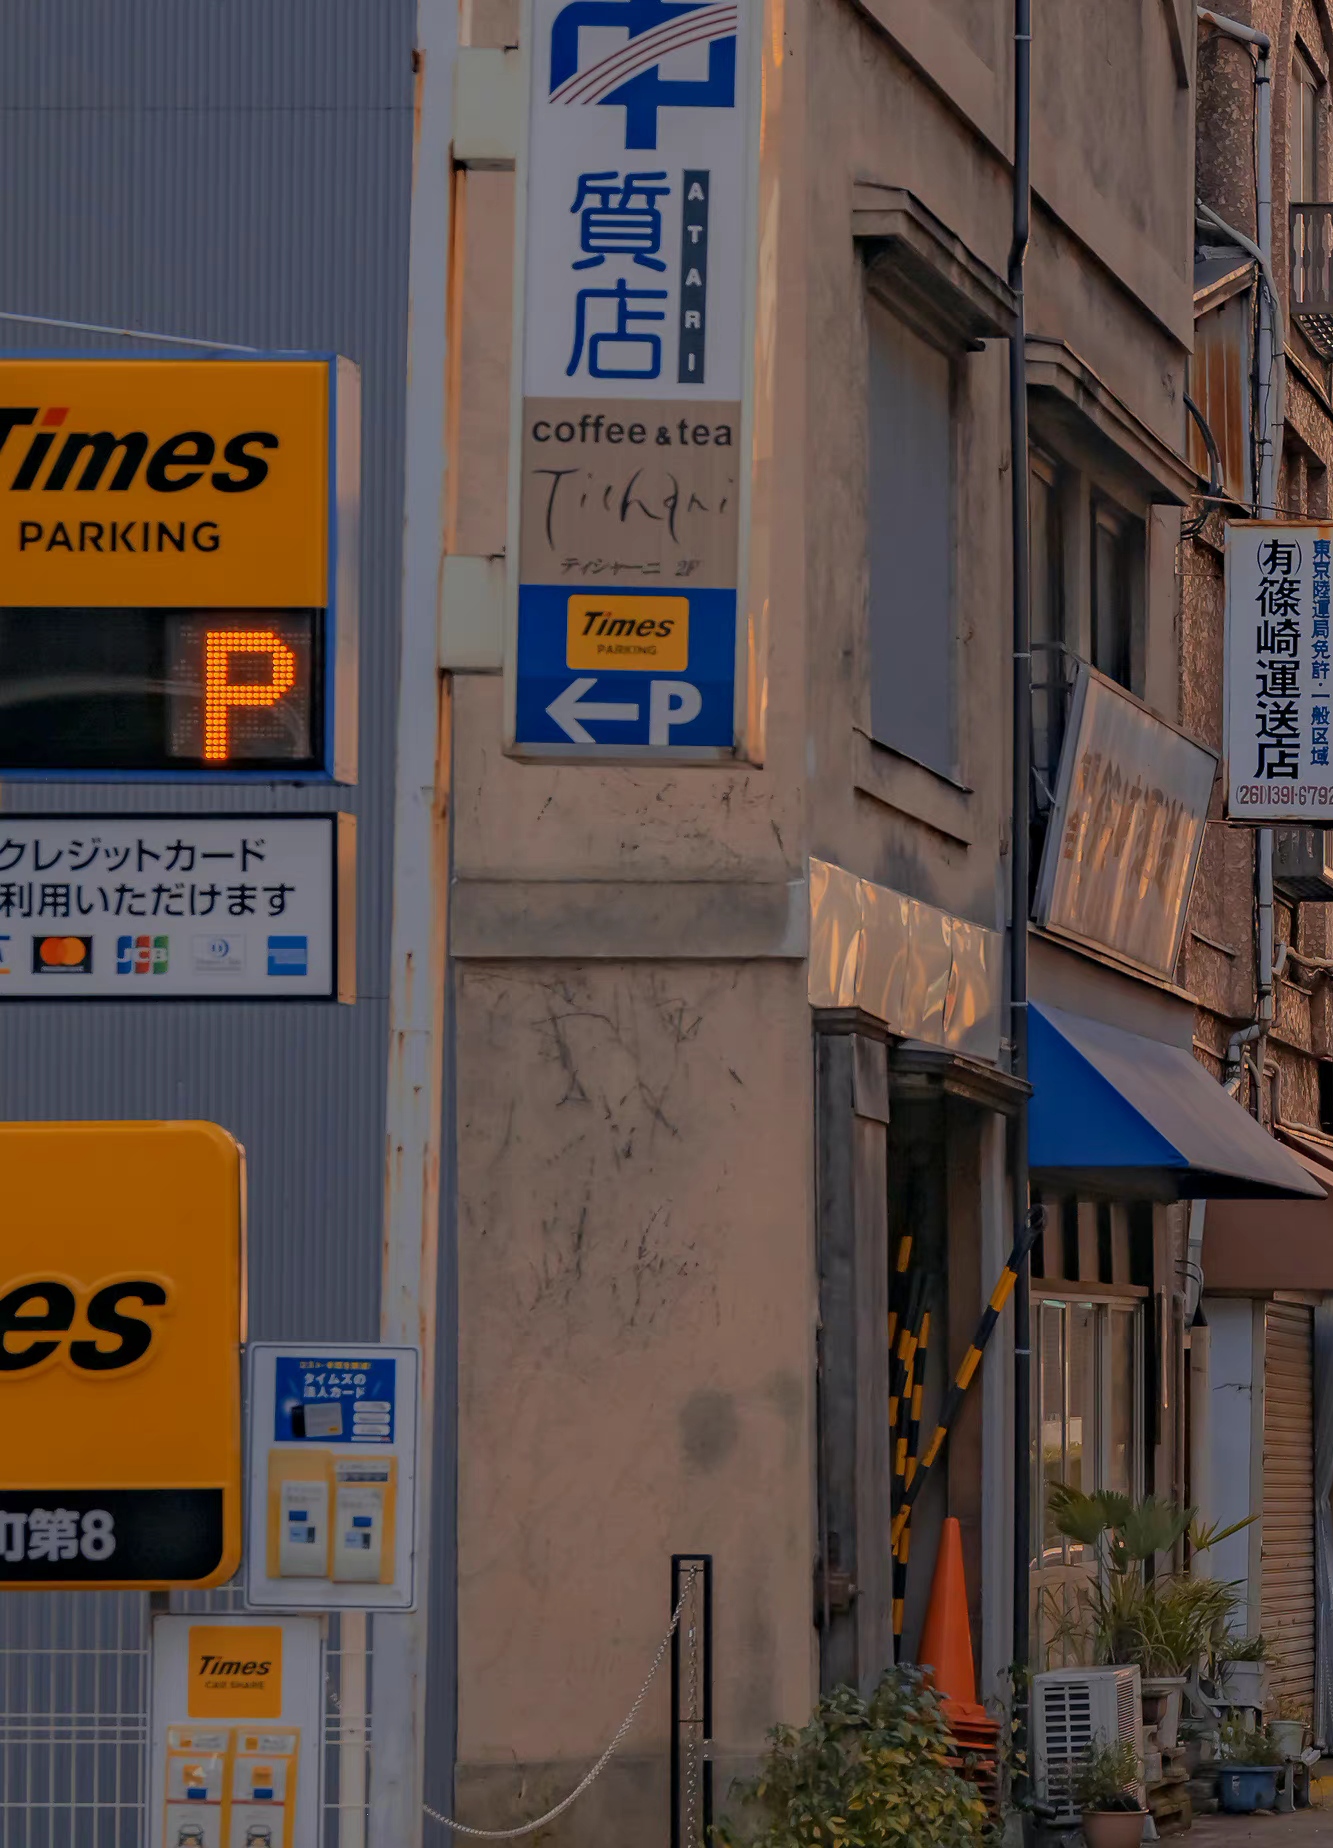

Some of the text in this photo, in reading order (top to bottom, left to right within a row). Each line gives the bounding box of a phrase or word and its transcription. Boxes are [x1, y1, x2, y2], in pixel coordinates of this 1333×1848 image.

[566, 171, 671, 379] 質店
[684, 182, 705, 372] ATARI
[532, 415, 732, 446] coffee & tea
[19, 520, 221, 552] PARKING
[582, 611, 675, 638] Times
[205, 630, 295, 760] P
[649, 680, 702, 746] P
[0, 838, 267, 872] クレジットカード
[0, 882, 296, 918] 利用いただけます
[199, 1655, 272, 1676] Times
